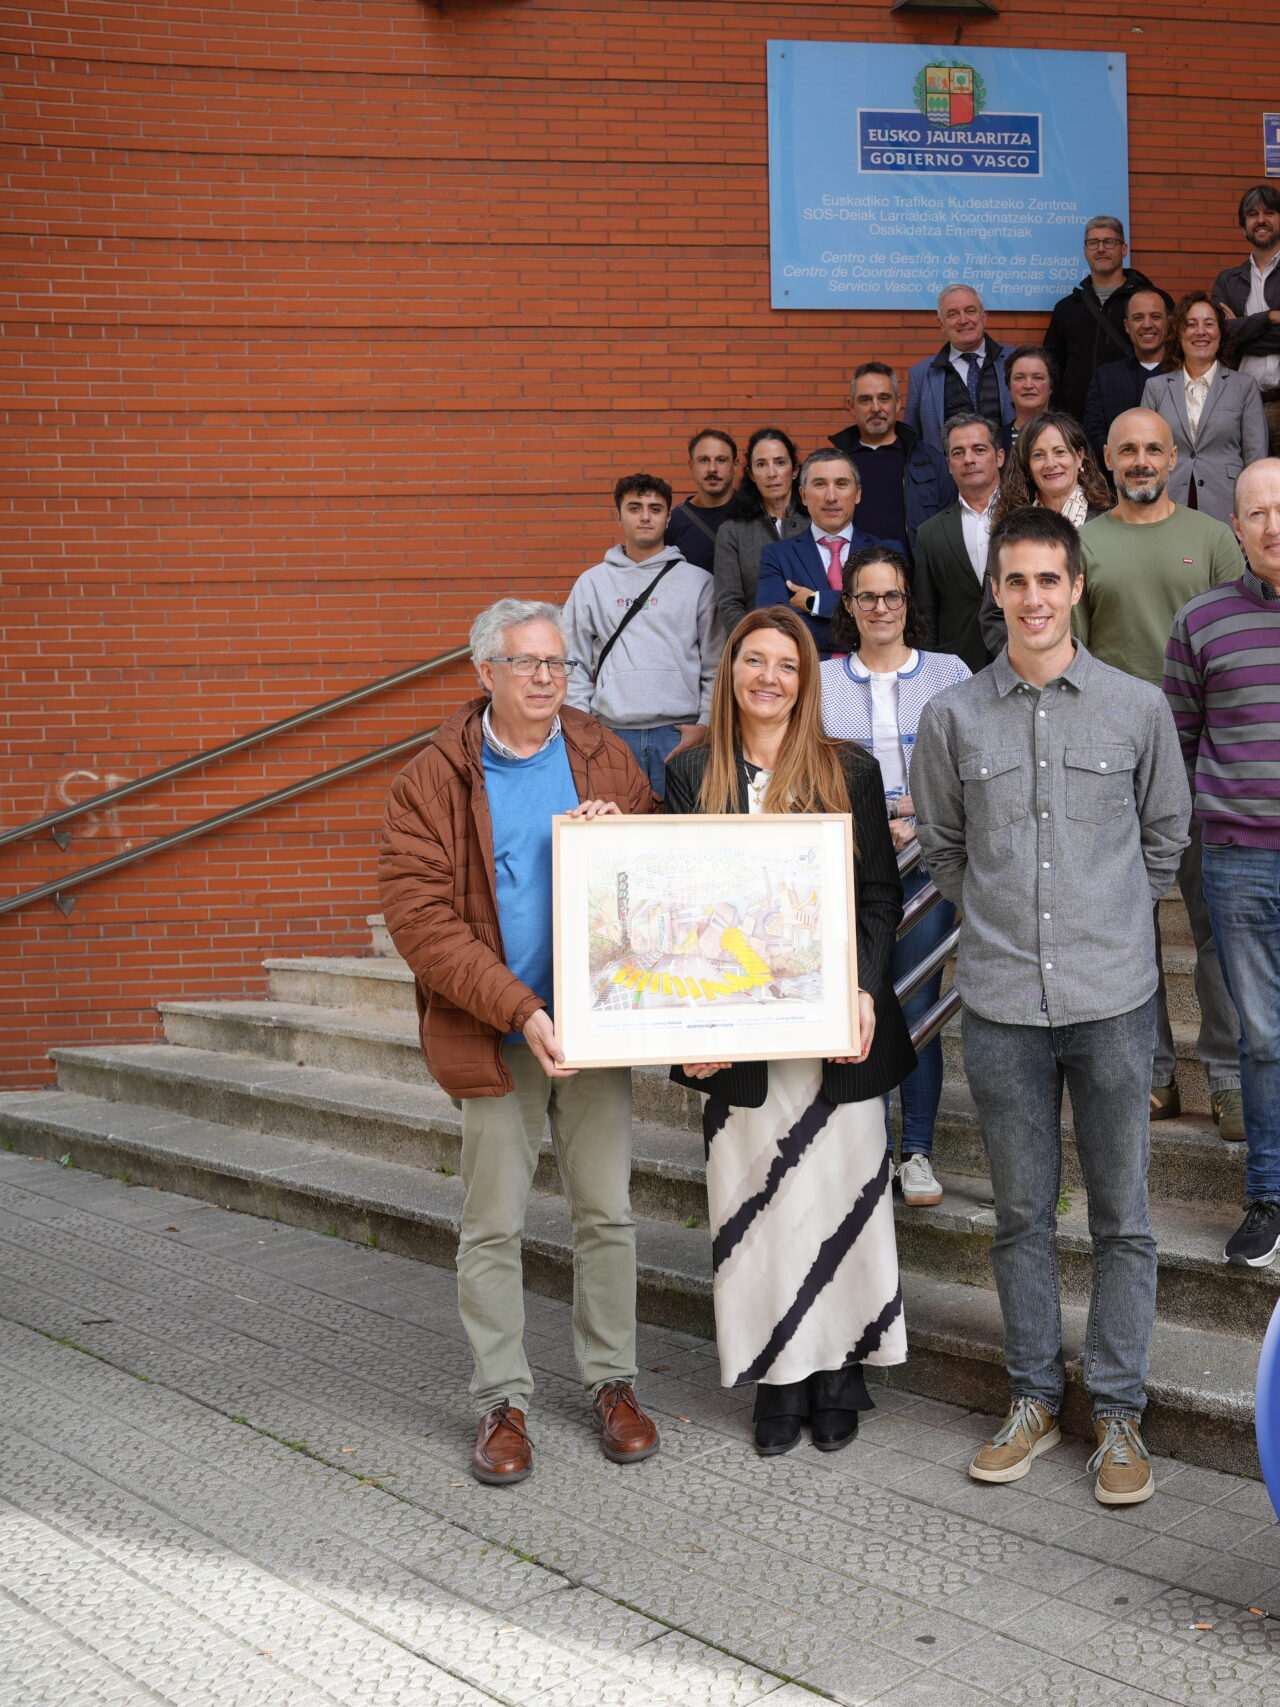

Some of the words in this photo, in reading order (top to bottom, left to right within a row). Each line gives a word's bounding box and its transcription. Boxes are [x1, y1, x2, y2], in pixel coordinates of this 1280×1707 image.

[868, 129, 921, 143] EUSKO
[926, 130, 1032, 145] JAURLARITZA
[870, 152, 964, 167] GOBIERNO
[971, 154, 1030, 168] VASCO
[822, 193, 890, 208] Euskadiko
[895, 195, 944, 208] Trafikoa
[948, 196, 1025, 210] Kudeatzeko
[1028, 198, 1078, 211] Zentroa
[951, 212, 1042, 224] Koordinatzeko
[869, 223, 942, 236] Osakidetza
[946, 224, 1032, 240] Emergentziak
[822, 250, 865, 263] Centro
[870, 252, 886, 264] de
[890, 250, 939, 264] Gestión
[944, 253, 960, 265] de
[1010, 254, 1026, 266] de
[1031, 254, 1079, 267] Euskadi
[783, 265, 828, 278] Centro
[832, 266, 848, 278] de
[943, 267, 959, 279] de
[962, 268, 1045, 282] Emergencias
[1050, 269, 1078, 280] SOS
[830, 280, 881, 292] Servicio
[885, 281, 923, 292] Vasco
